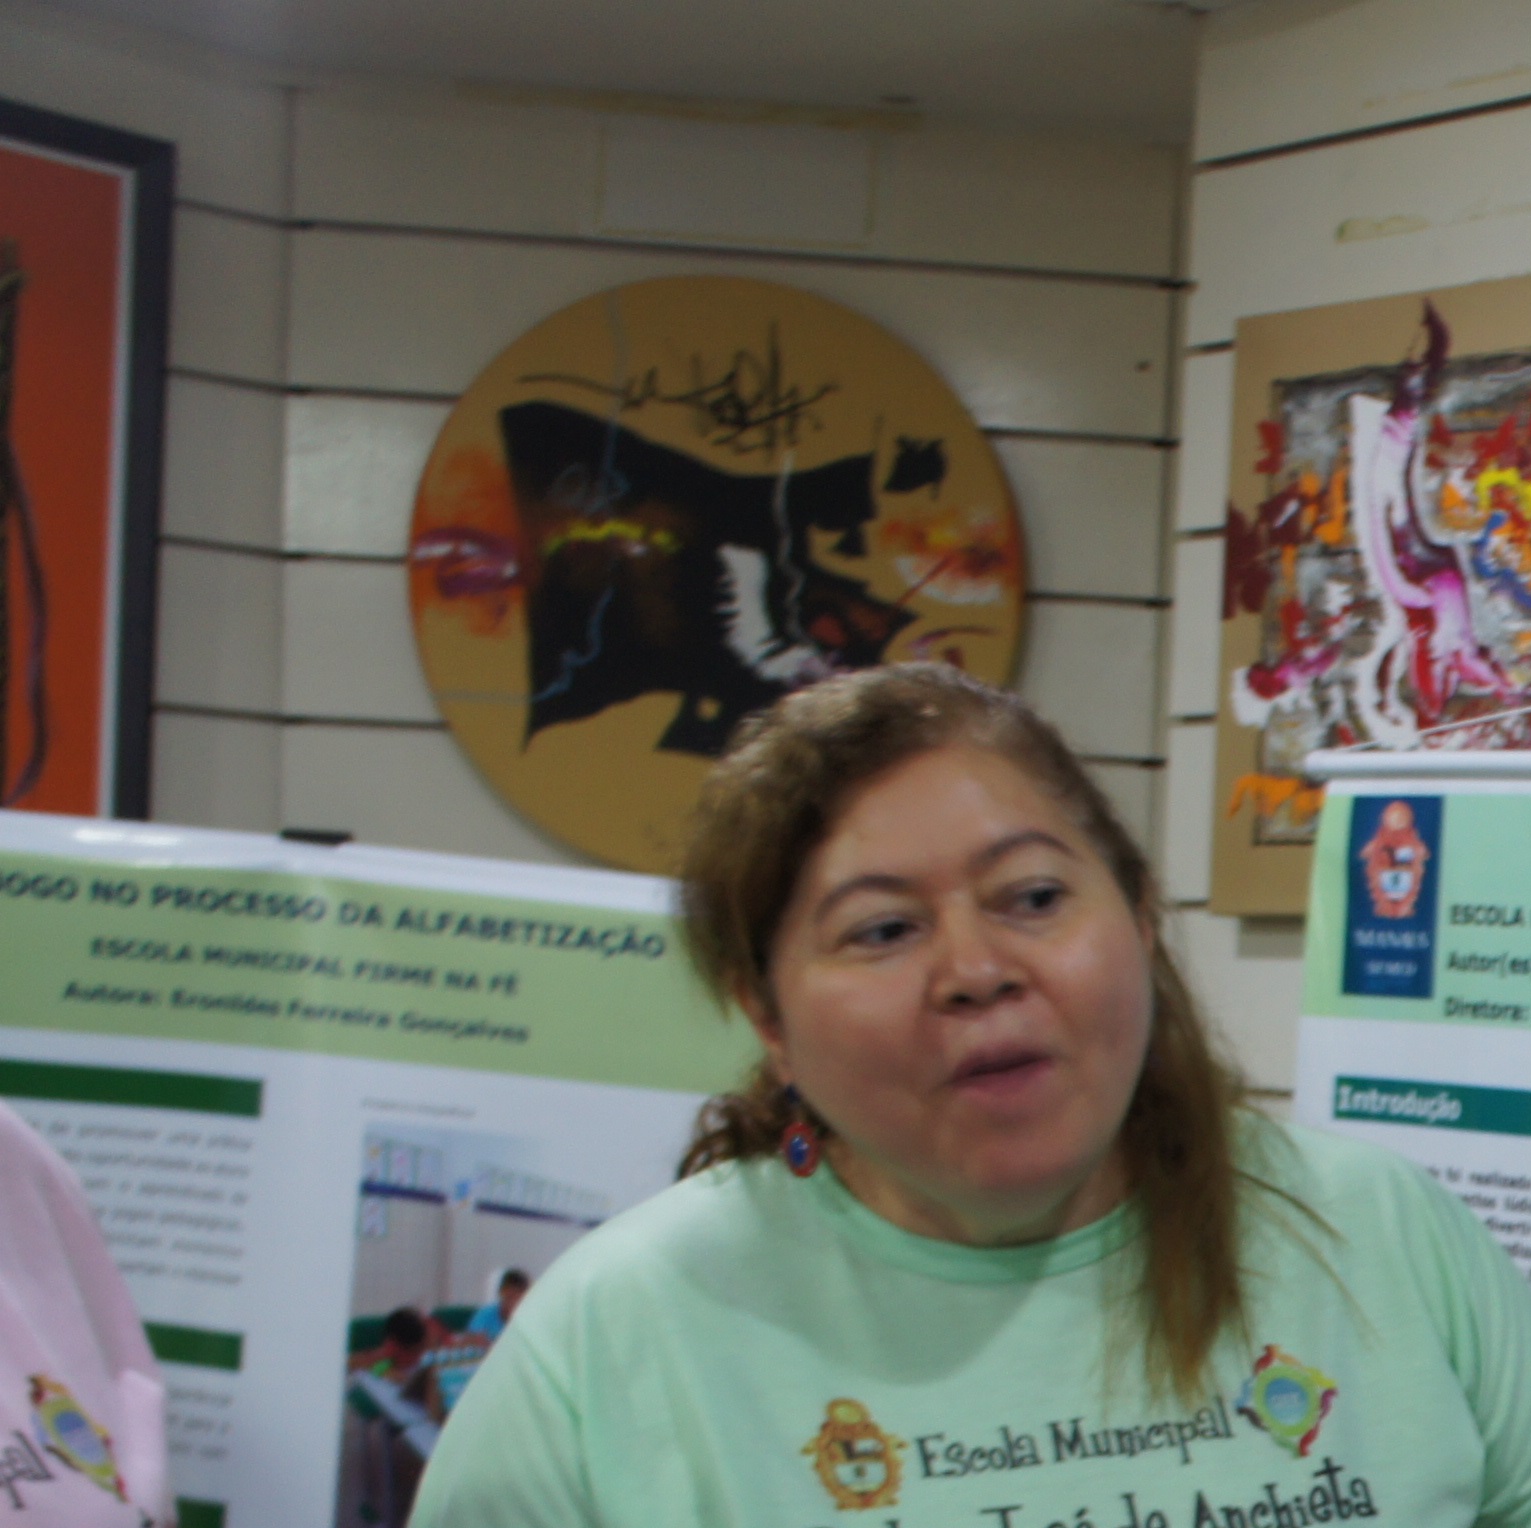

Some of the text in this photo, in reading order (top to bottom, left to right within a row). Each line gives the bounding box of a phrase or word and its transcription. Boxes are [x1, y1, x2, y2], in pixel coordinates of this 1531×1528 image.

[0, 870, 666, 959] OGO NO PROCESSO DA ALFABETIZAÇÃO
[1449, 903, 1525, 929] ESCOLA
[90, 936, 192, 962] ESCOLA
[1444, 996, 1527, 1023] Diretora:
[1338, 1084, 1463, 1125] Introdução
[916, 1398, 1236, 1480] Escola Municipal
